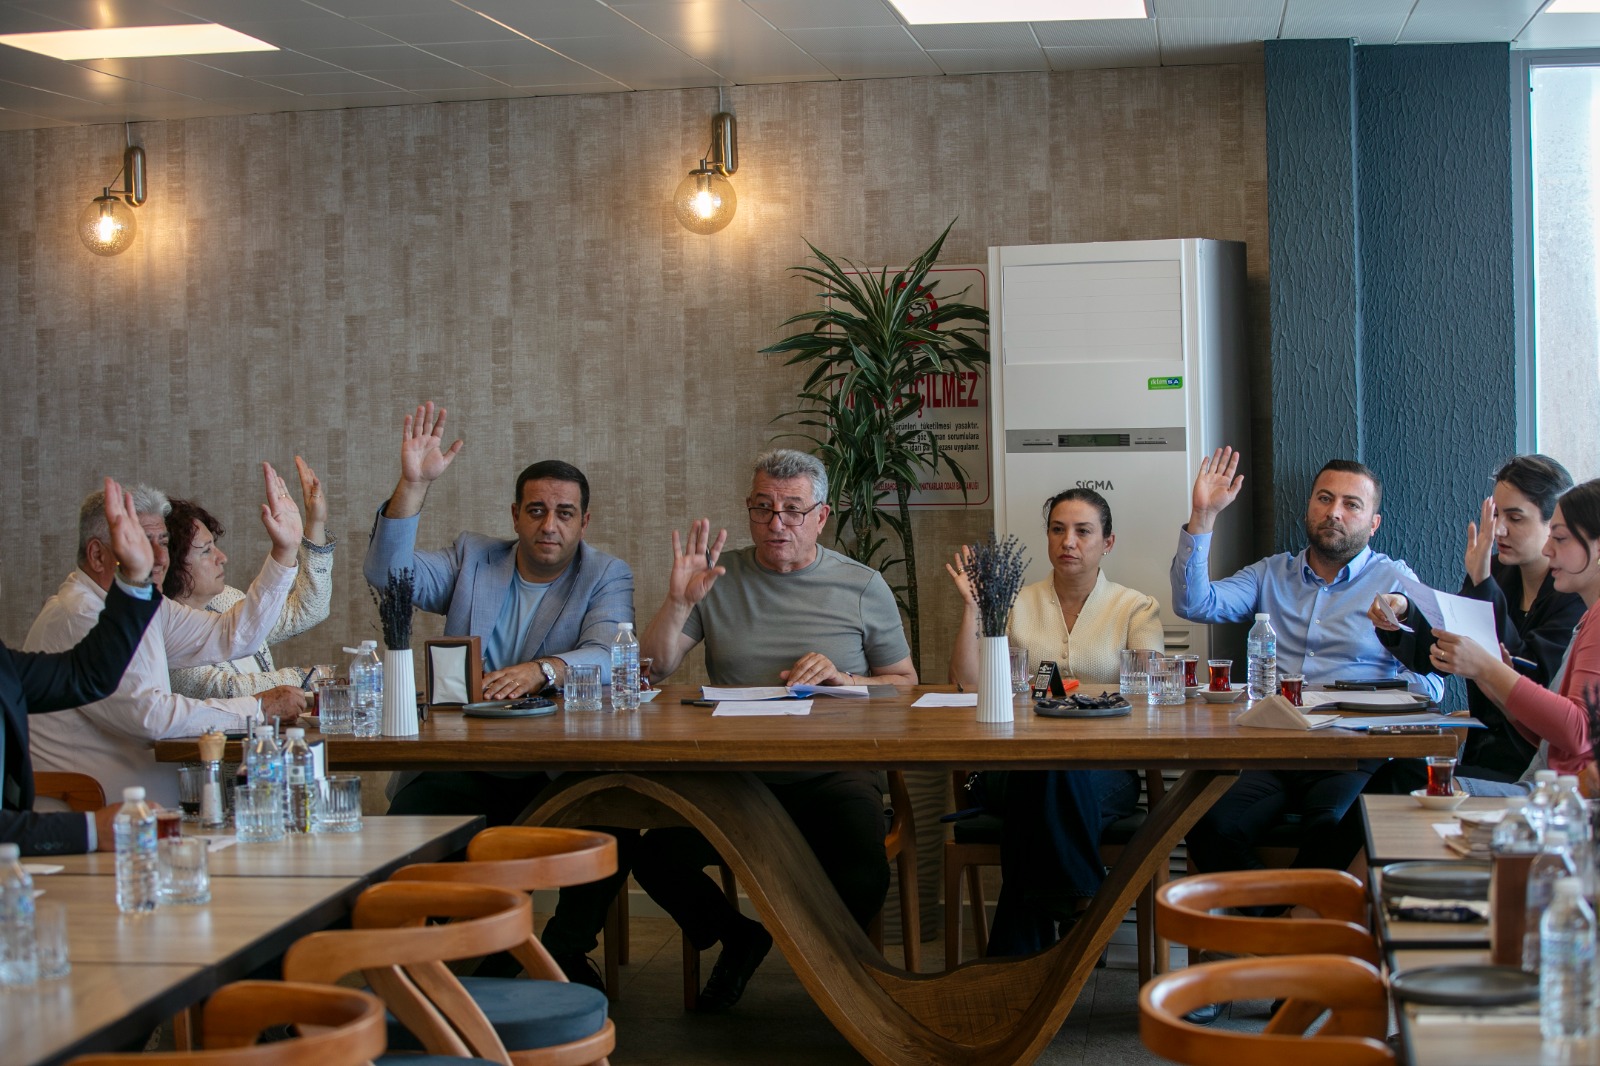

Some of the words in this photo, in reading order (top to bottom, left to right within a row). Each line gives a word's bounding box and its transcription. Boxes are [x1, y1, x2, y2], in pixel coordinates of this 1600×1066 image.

[920, 422, 952, 430] tüketilmesi
[947, 432, 980, 440] sorumlulara
[1075, 480, 1114, 491] SIGMA
